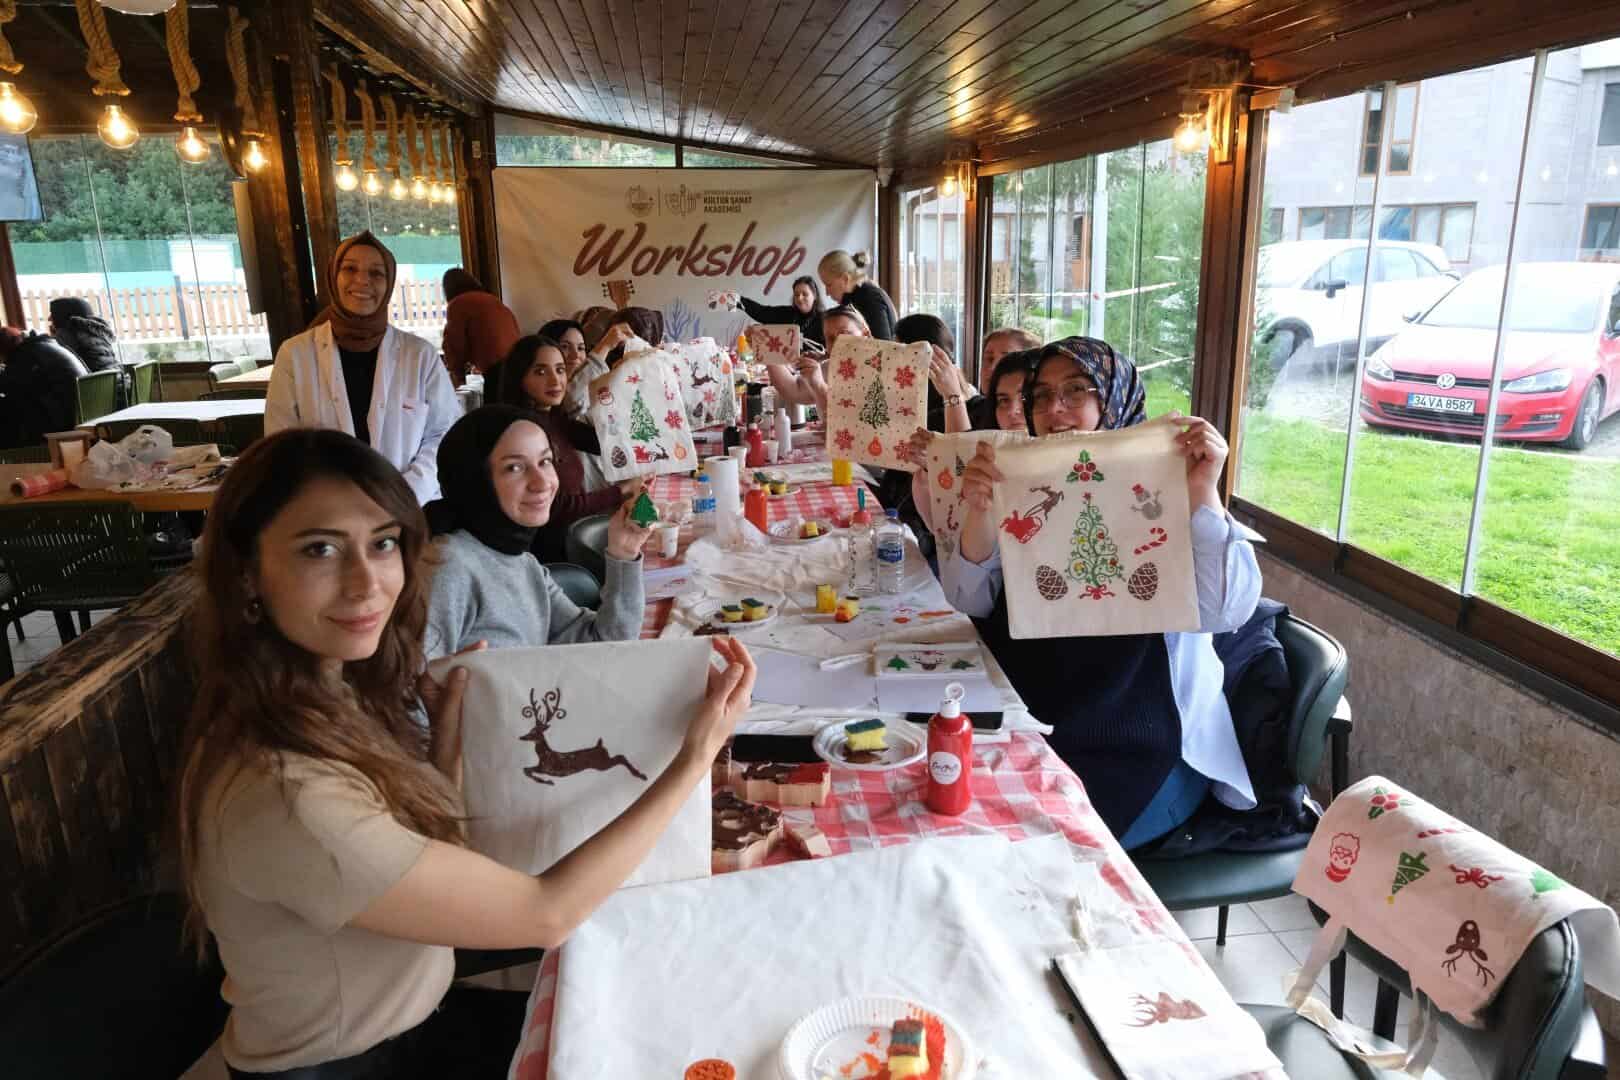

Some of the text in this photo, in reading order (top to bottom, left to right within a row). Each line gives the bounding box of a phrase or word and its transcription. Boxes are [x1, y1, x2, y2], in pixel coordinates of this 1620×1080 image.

[573, 220, 807, 296] Workshop
[1415, 395, 1426, 406] 34
[1429, 397, 1443, 409] VA
